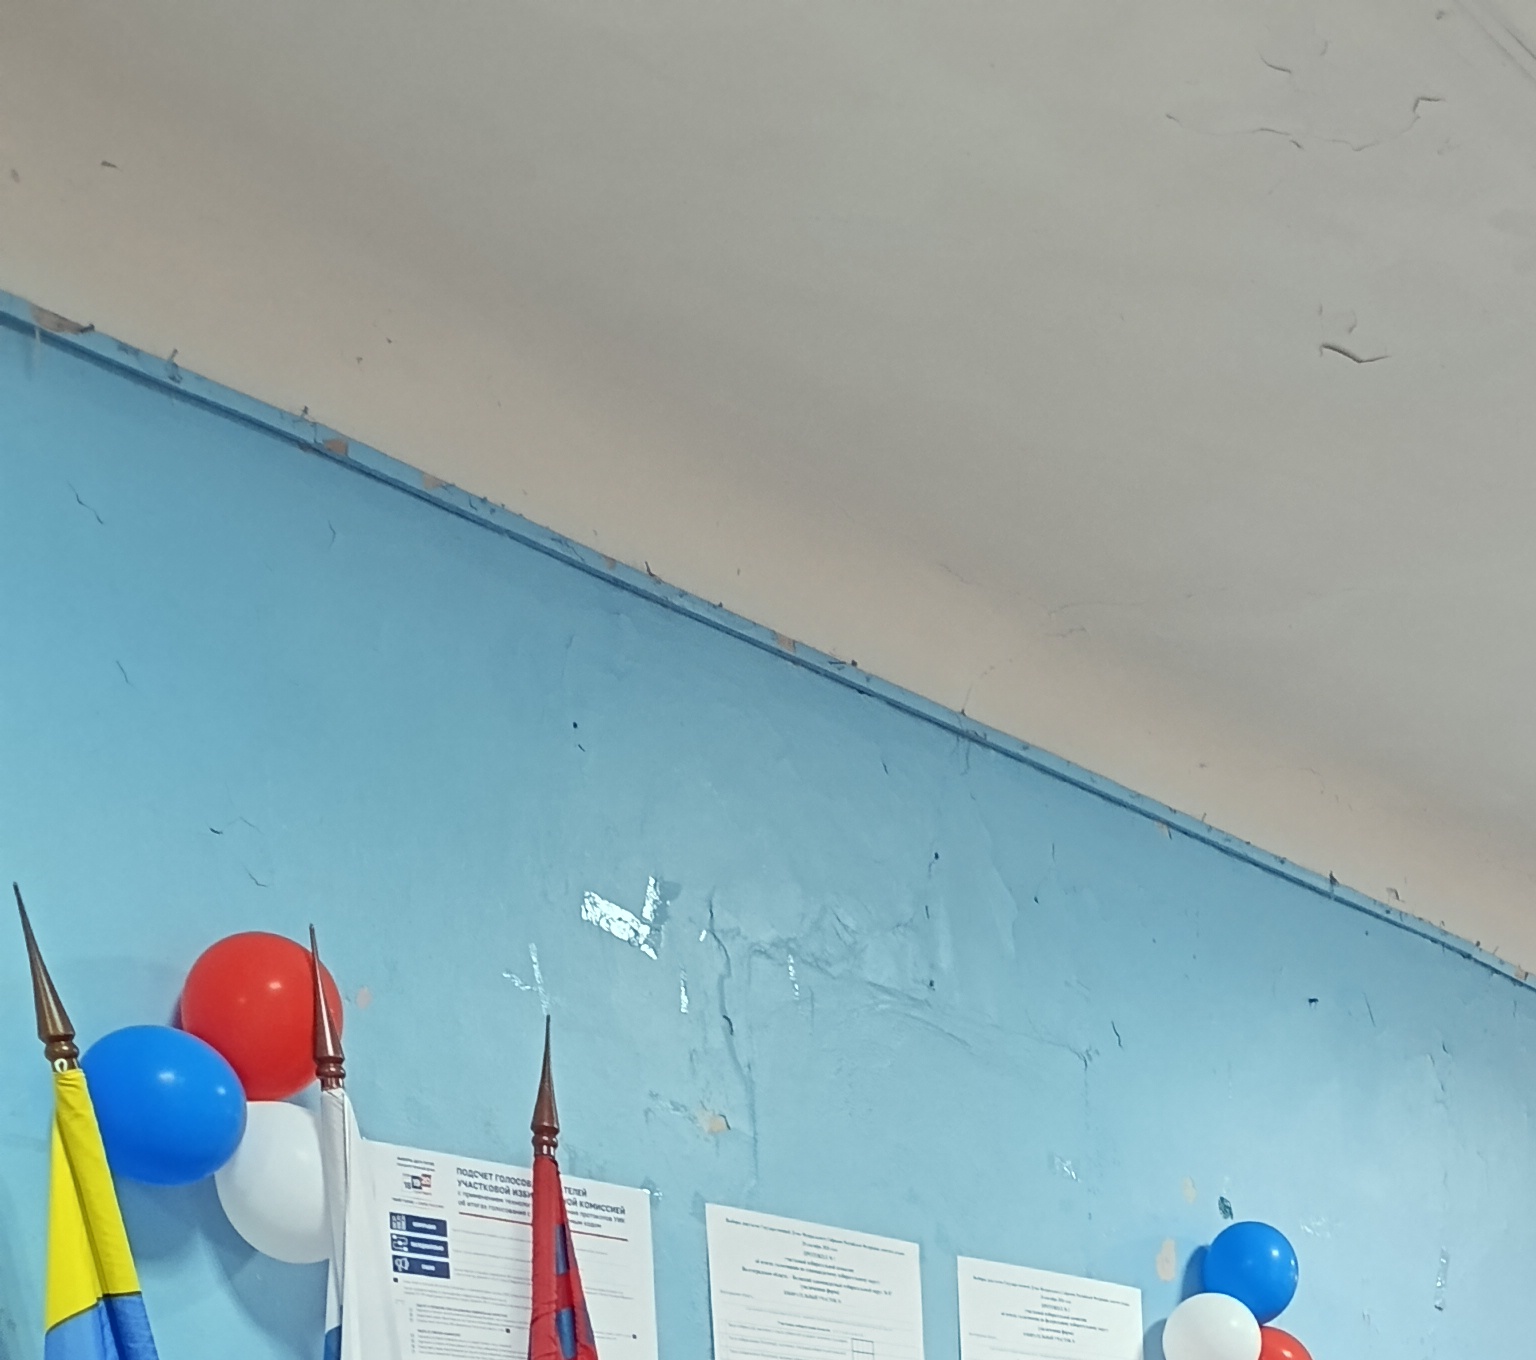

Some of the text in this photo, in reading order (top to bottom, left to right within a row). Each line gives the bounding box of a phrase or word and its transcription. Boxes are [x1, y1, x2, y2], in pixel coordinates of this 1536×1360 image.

[456, 1167, 493, 1181] ПОДСЧЕТ
[495, 1174, 532, 1188] ГОЛОСОВ
[457, 1179, 510, 1195] УЧАСТКОВОЙ
[579, 1199, 626, 1215] КОМИССИЕЙ
